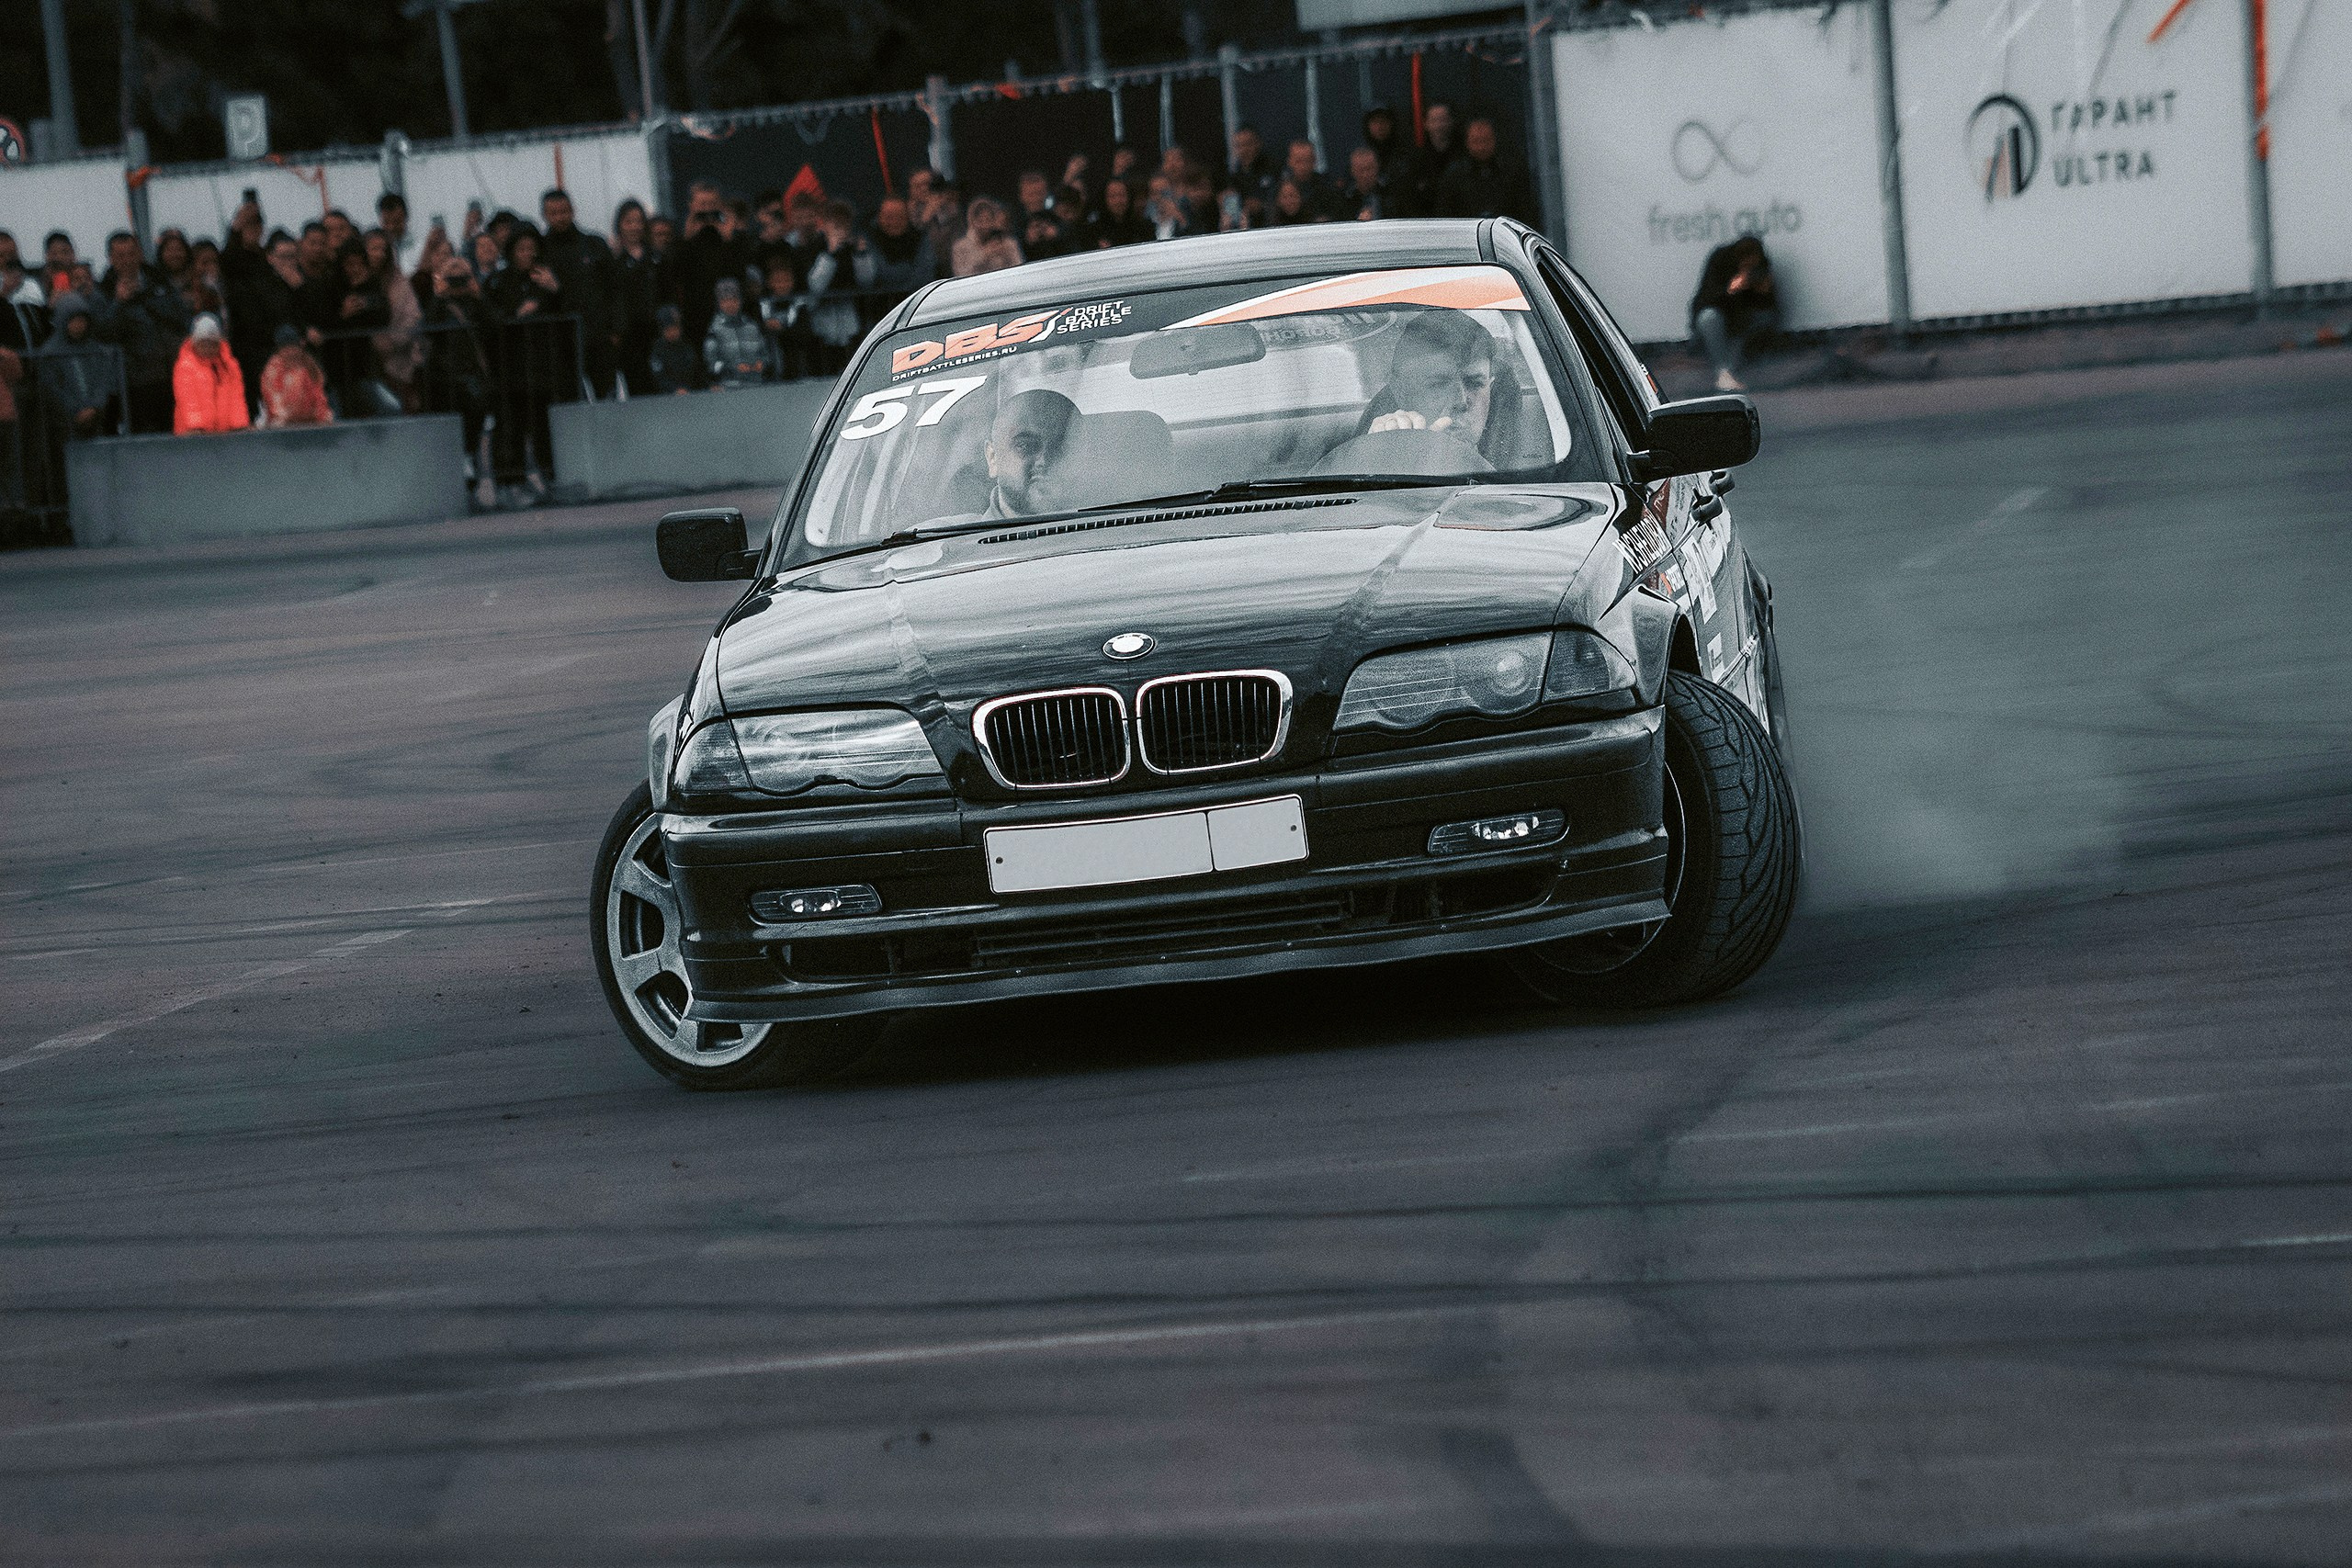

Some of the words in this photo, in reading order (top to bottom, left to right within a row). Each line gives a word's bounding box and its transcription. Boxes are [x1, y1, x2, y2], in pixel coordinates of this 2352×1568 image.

[2053, 149, 2154, 186] ULTRA
[1647, 204, 1730, 247] fresh
[1057, 315, 1122, 334] SERIES
[1065, 306, 1131, 325] BATTLE
[1074, 300, 1124, 316] DRIFT
[892, 310, 1060, 374] DBS
[892, 345, 1017, 381] DRIFTBATTLESERIES.RU
[840, 375, 987, 440] 57
